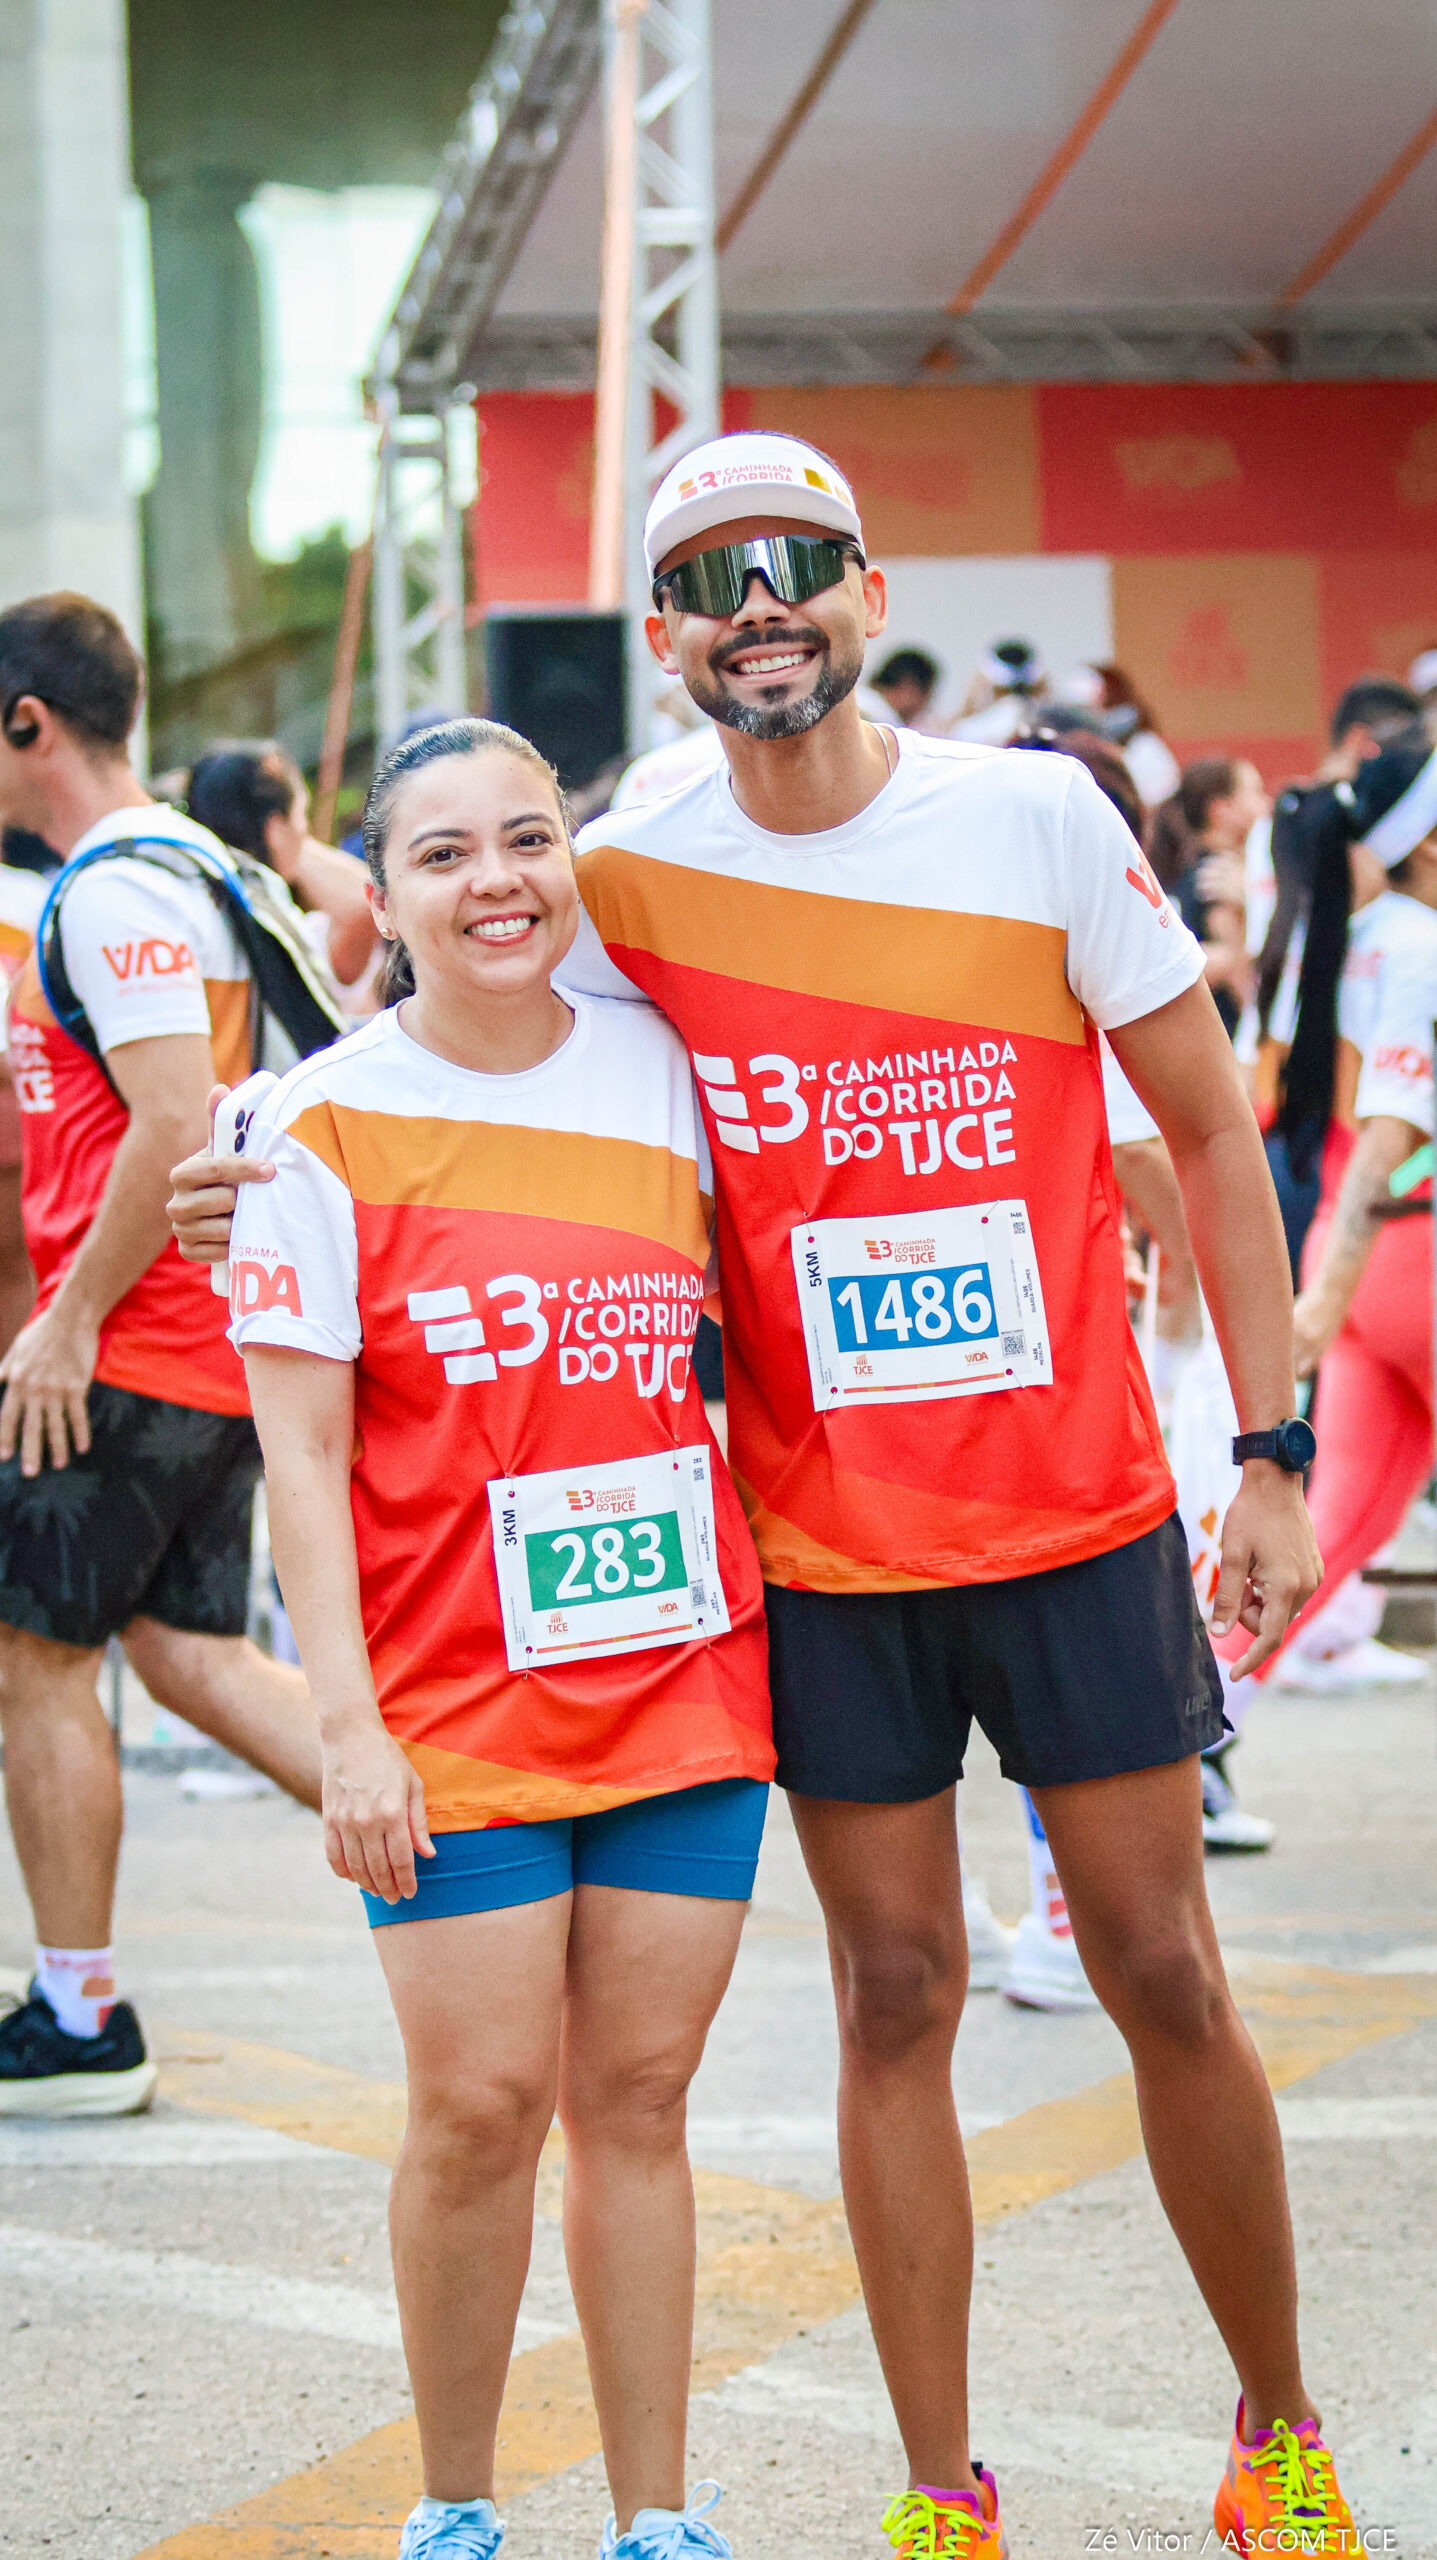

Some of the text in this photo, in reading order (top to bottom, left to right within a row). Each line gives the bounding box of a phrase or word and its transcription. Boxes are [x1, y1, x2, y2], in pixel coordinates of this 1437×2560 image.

[724, 464, 793, 475] CAMINHADA
[826, 1039, 1018, 1086] CAMINHADA
[749, 1053, 818, 1144] 3ª
[820, 1069, 1017, 1125] /CORRIDA
[823, 1107, 1017, 1176] DO TJCE
[894, 1244, 936, 1255] /CORRIDA
[895, 1238, 936, 1247] CAMINHADA
[895, 1252, 936, 1265] DO TJCE
[805, 1251, 822, 1288] 5KM
[229, 1260, 303, 1318] IDA
[567, 1272, 705, 1304] CAMINHADA
[486, 1274, 559, 1368] 3ª
[836, 1268, 993, 1344] 1486
[558, 1343, 619, 1386] DO
[853, 1365, 874, 1375] TJCE
[964, 1351, 989, 1363] VIDA
[596, 1499, 636, 1514] DO TJCE
[598, 1485, 636, 1497] CAMINHADA
[502, 1508, 518, 1547] 3KM
[550, 1521, 667, 1601] 283
[657, 1602, 679, 1614] VIDA
[547, 1623, 569, 1634] TJCE
